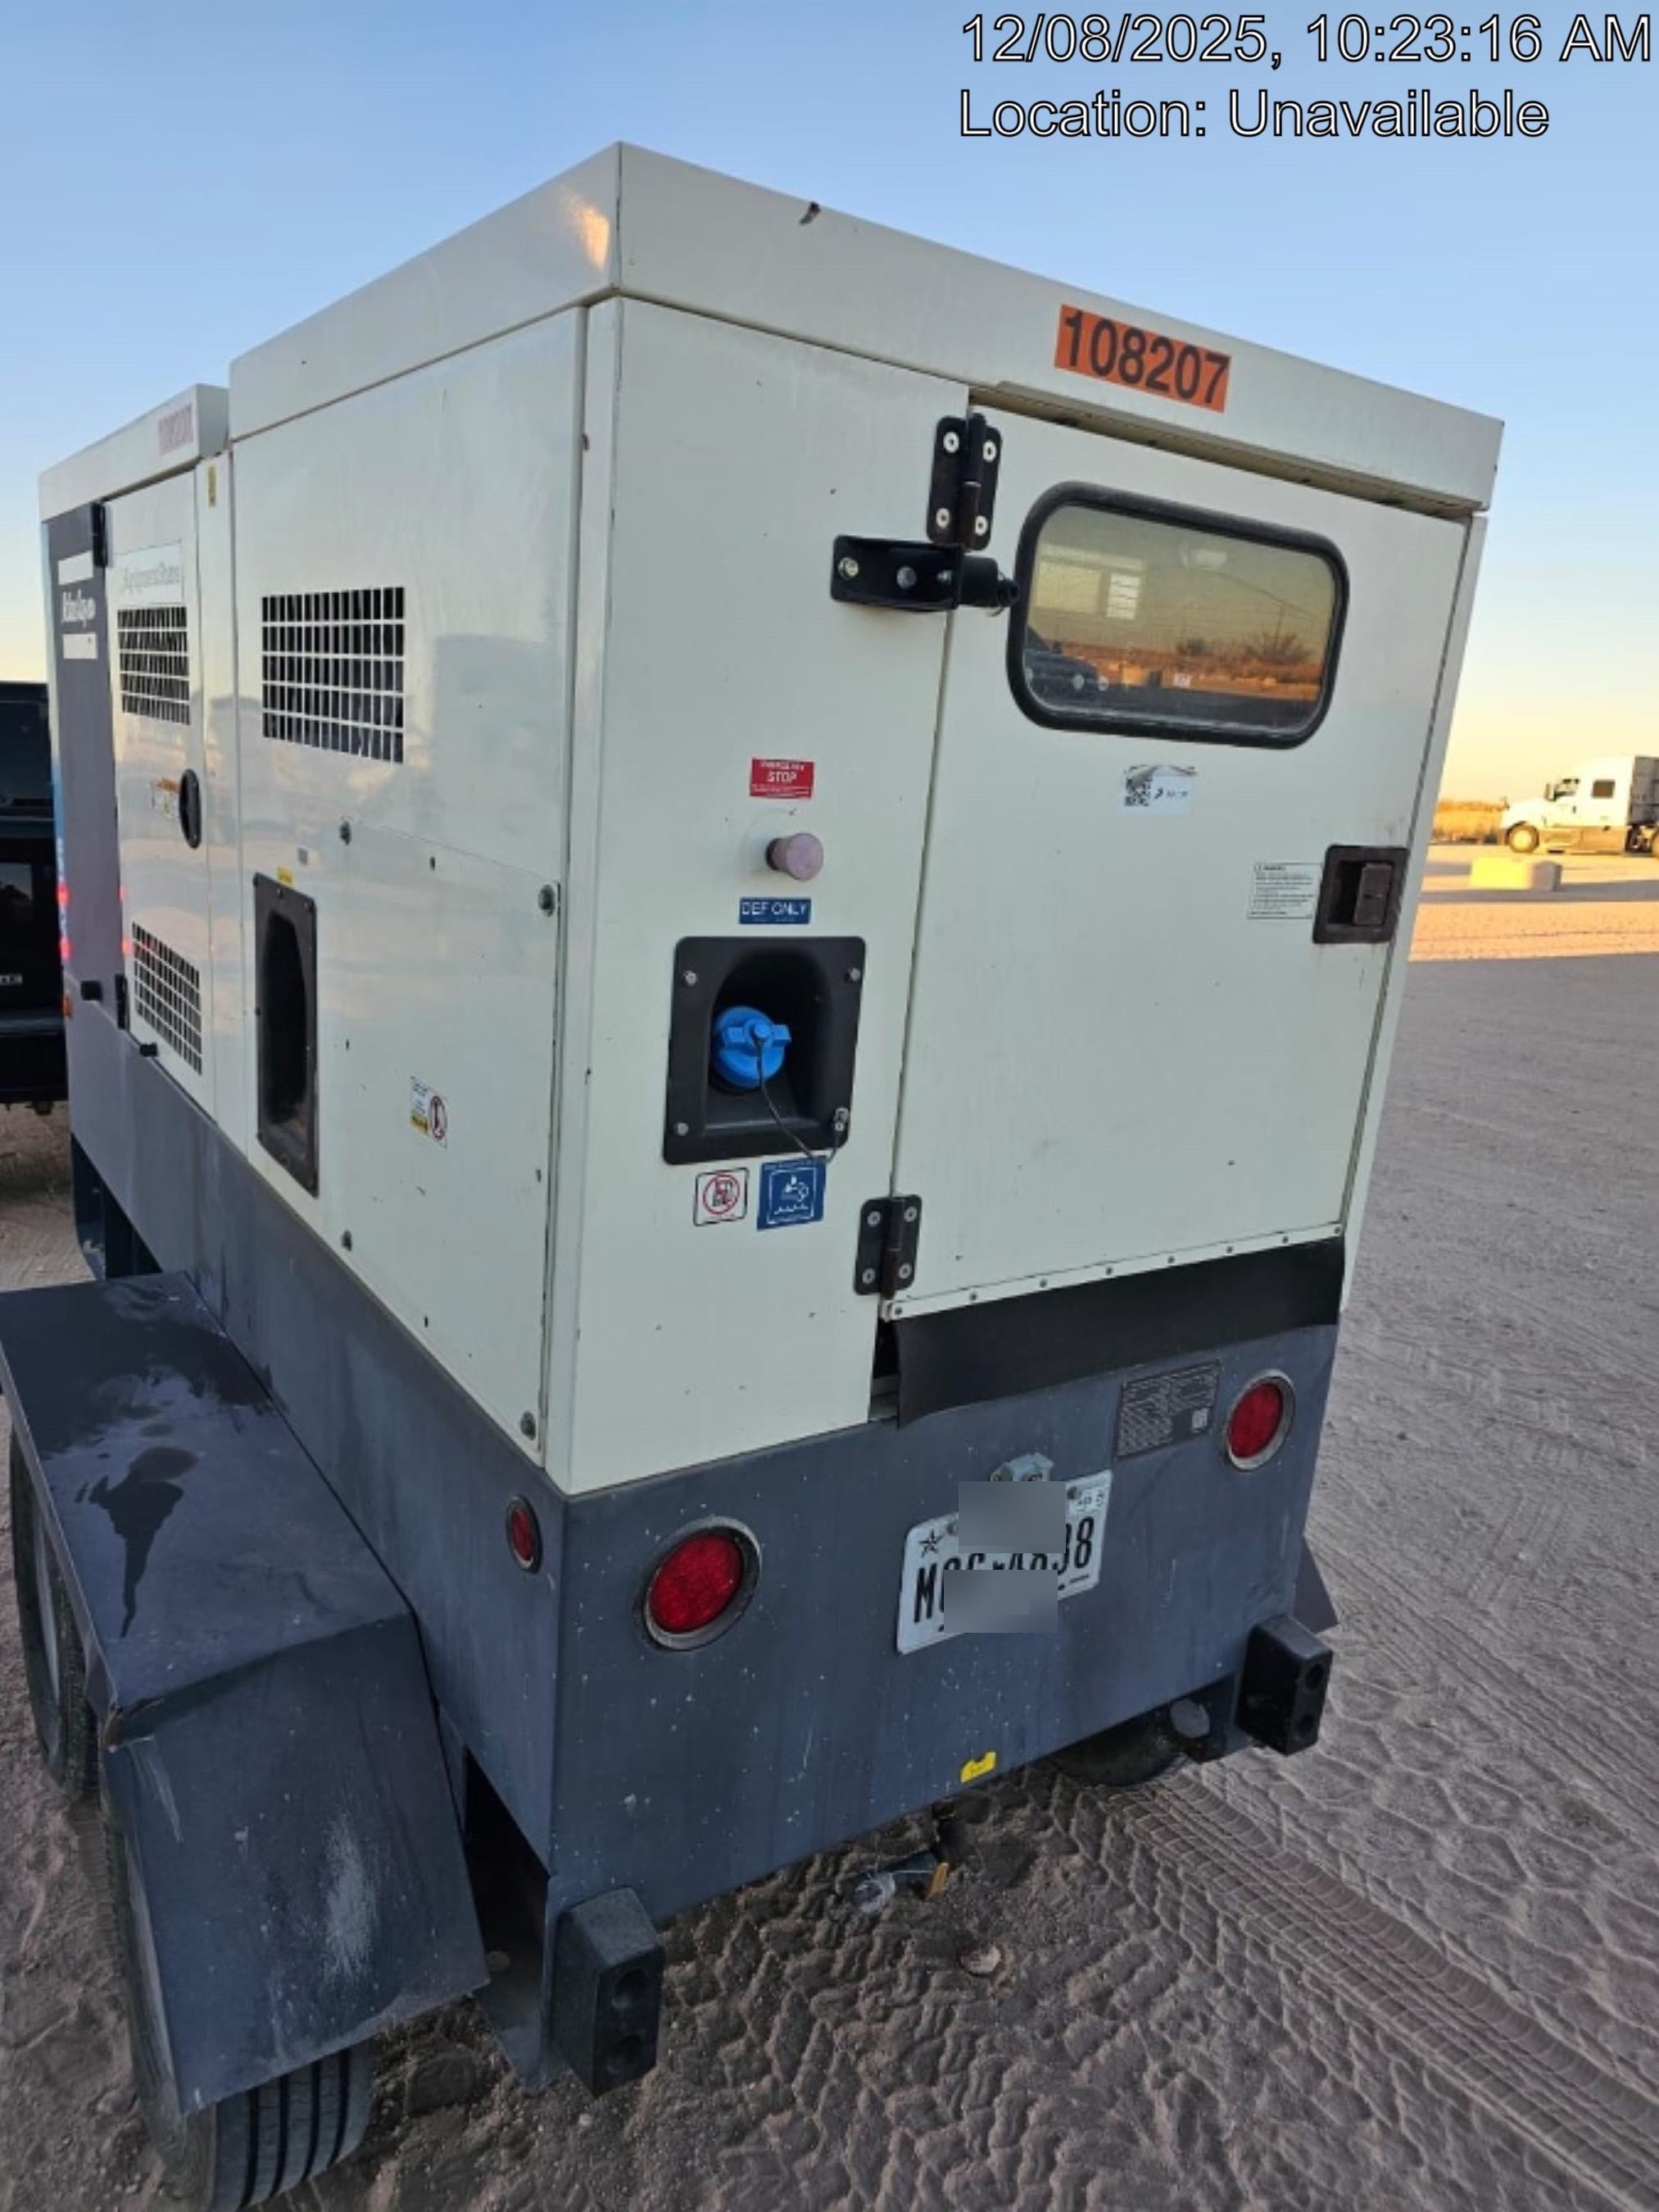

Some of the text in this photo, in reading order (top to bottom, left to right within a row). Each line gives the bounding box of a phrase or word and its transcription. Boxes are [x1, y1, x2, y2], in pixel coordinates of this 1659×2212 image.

[1065, 309, 1231, 404] 108207
[768, 770, 797, 784] STOP
[741, 901, 807, 916] DEF ONLY
